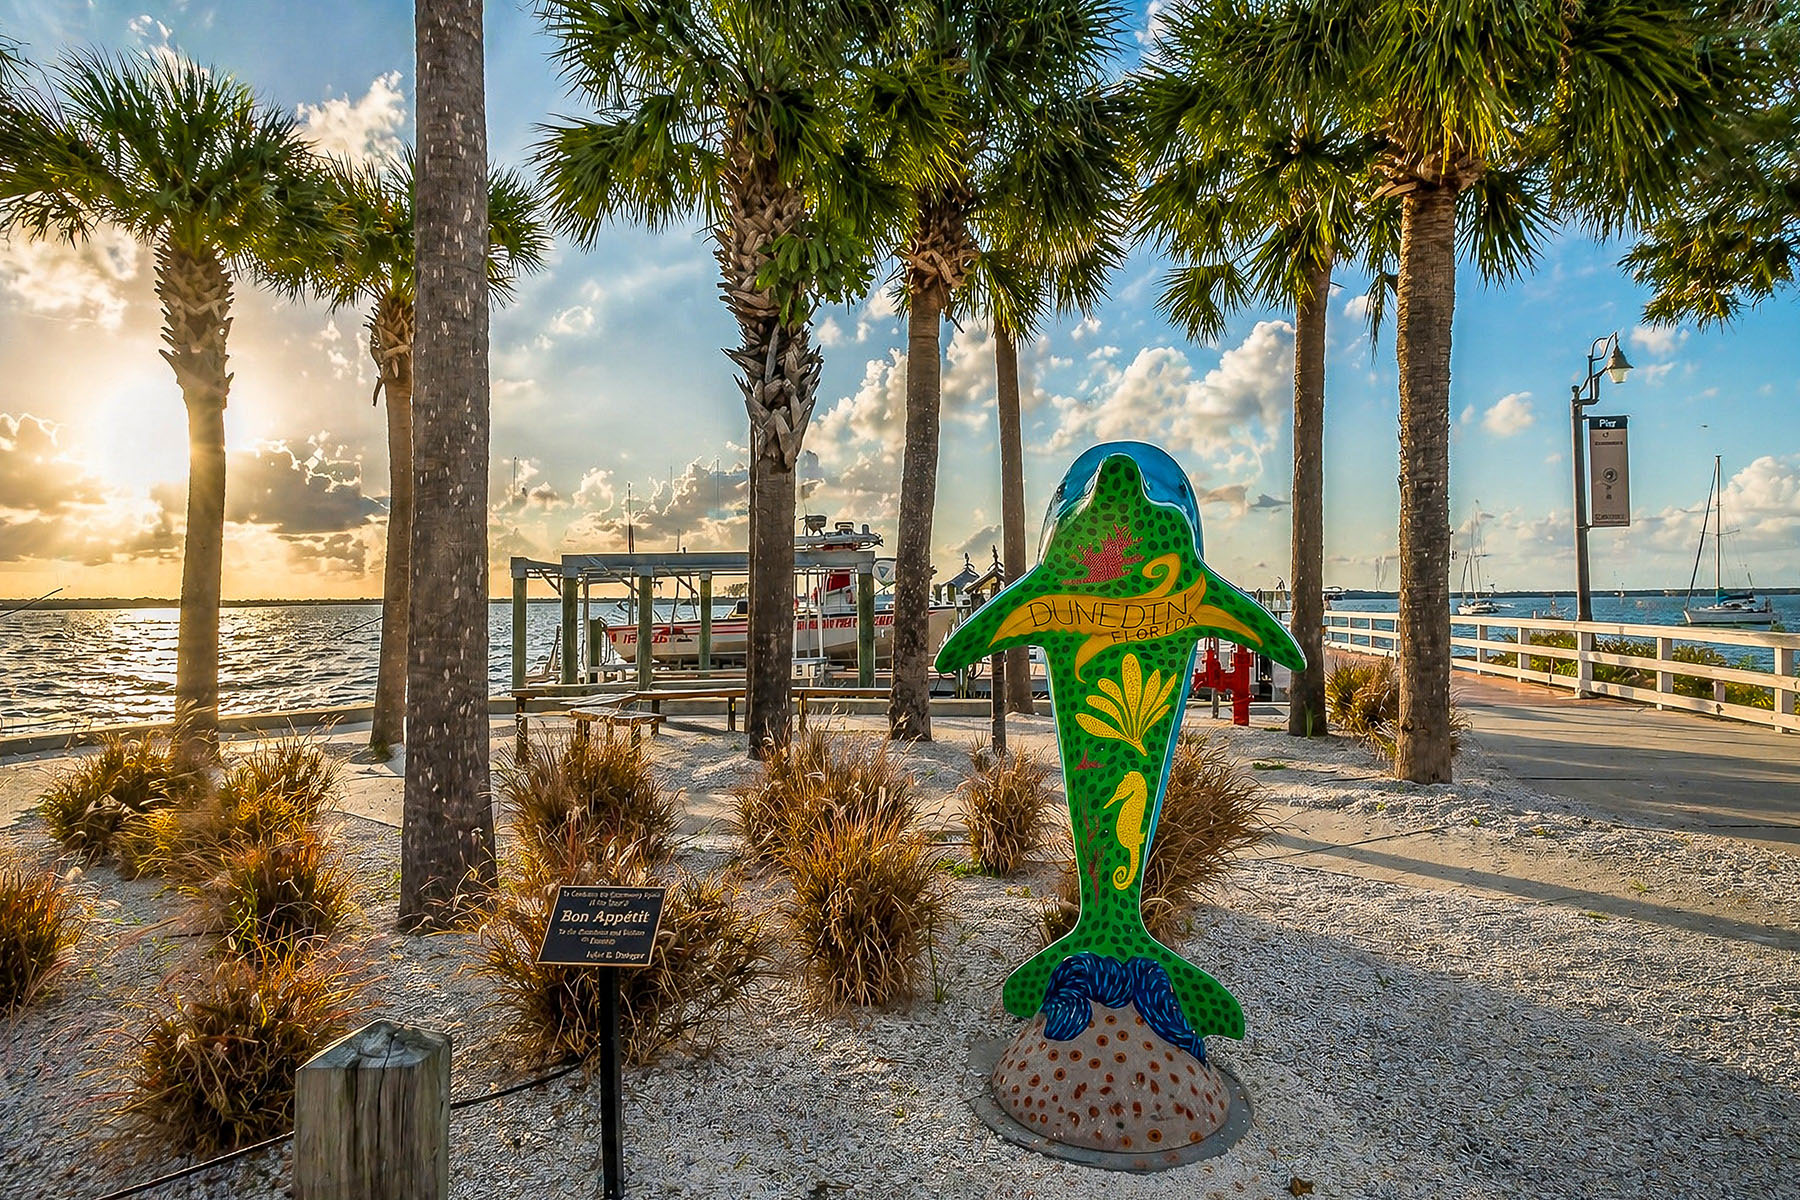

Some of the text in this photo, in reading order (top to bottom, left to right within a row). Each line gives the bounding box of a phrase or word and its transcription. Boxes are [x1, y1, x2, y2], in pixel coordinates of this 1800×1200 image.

[1027, 593, 1188, 629] DUNEDIN
[1110, 615, 1198, 643] FLORIDA
[560, 909, 650, 926] Bon Appétit
